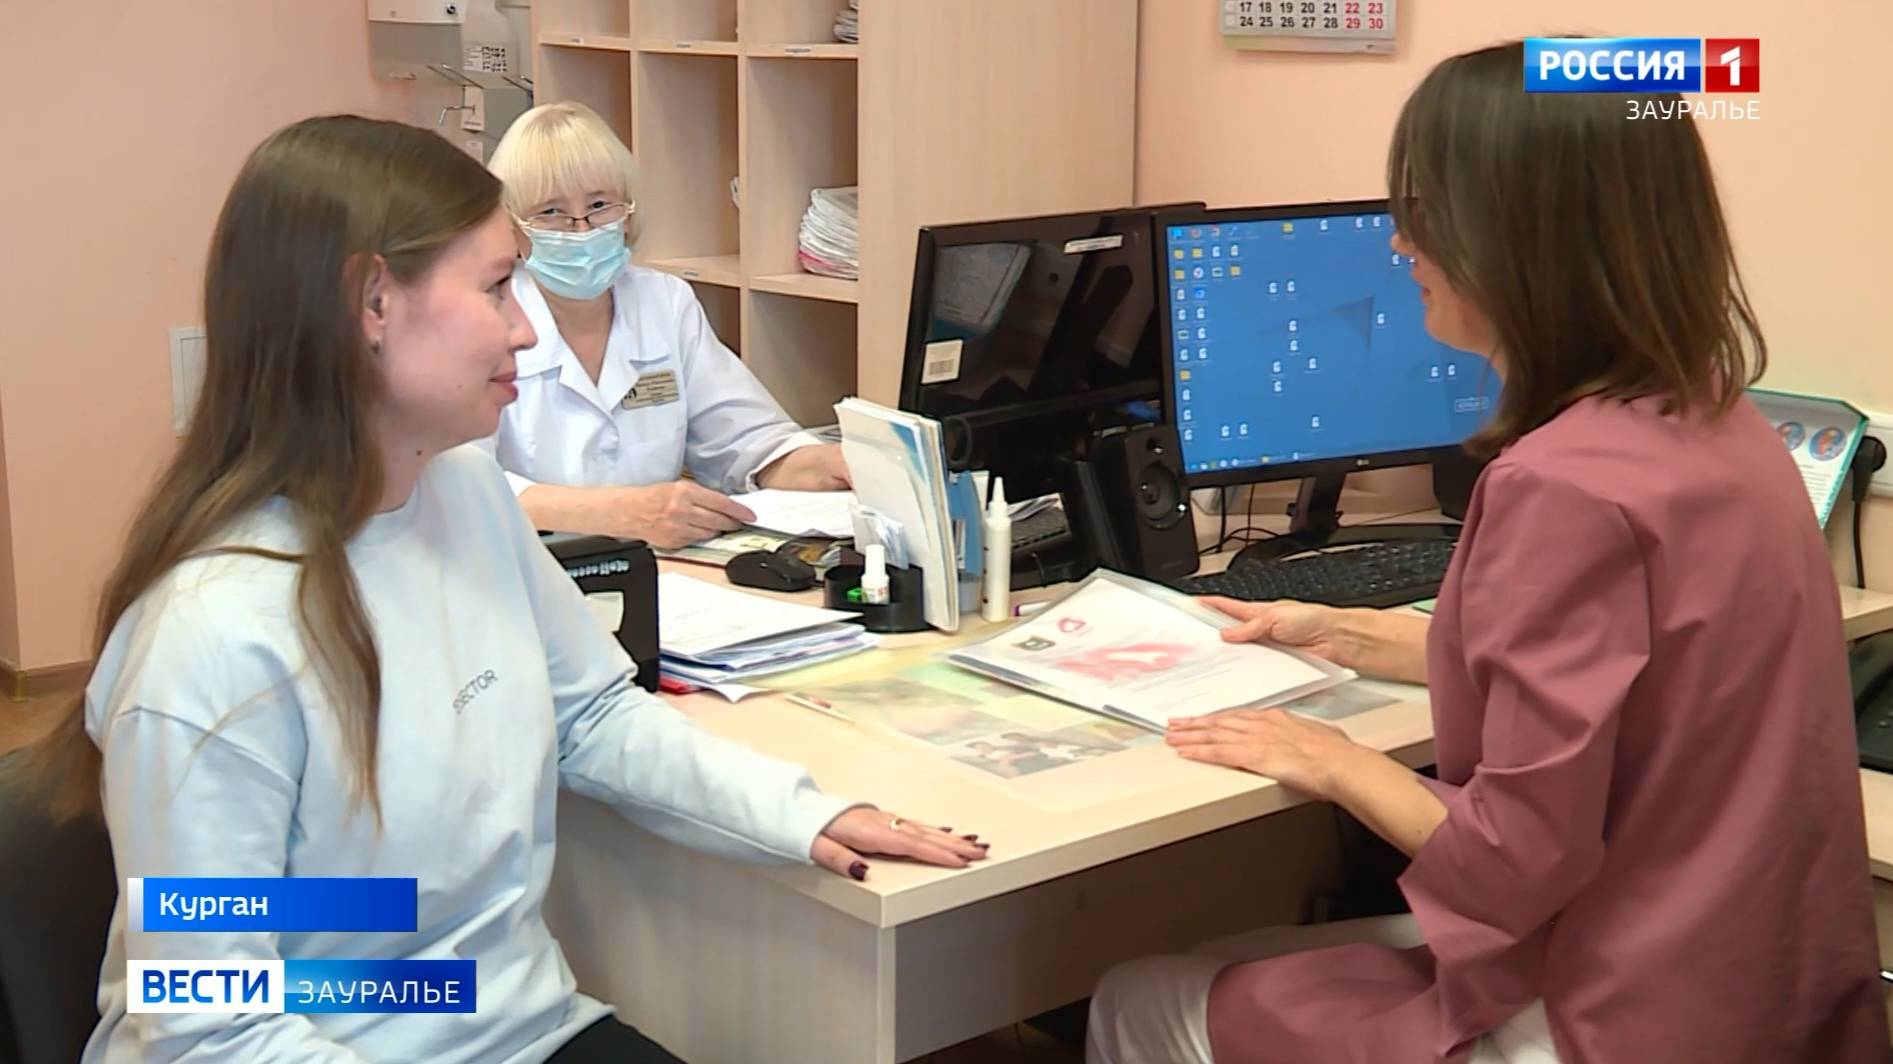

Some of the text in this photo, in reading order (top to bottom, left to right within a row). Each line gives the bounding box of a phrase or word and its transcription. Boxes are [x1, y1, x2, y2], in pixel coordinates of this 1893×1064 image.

[1239, 2, 1383, 14] 17 18 19 20 21 22 23
[1239, 16, 1383, 29] 24 25 26 27 28 29 30
